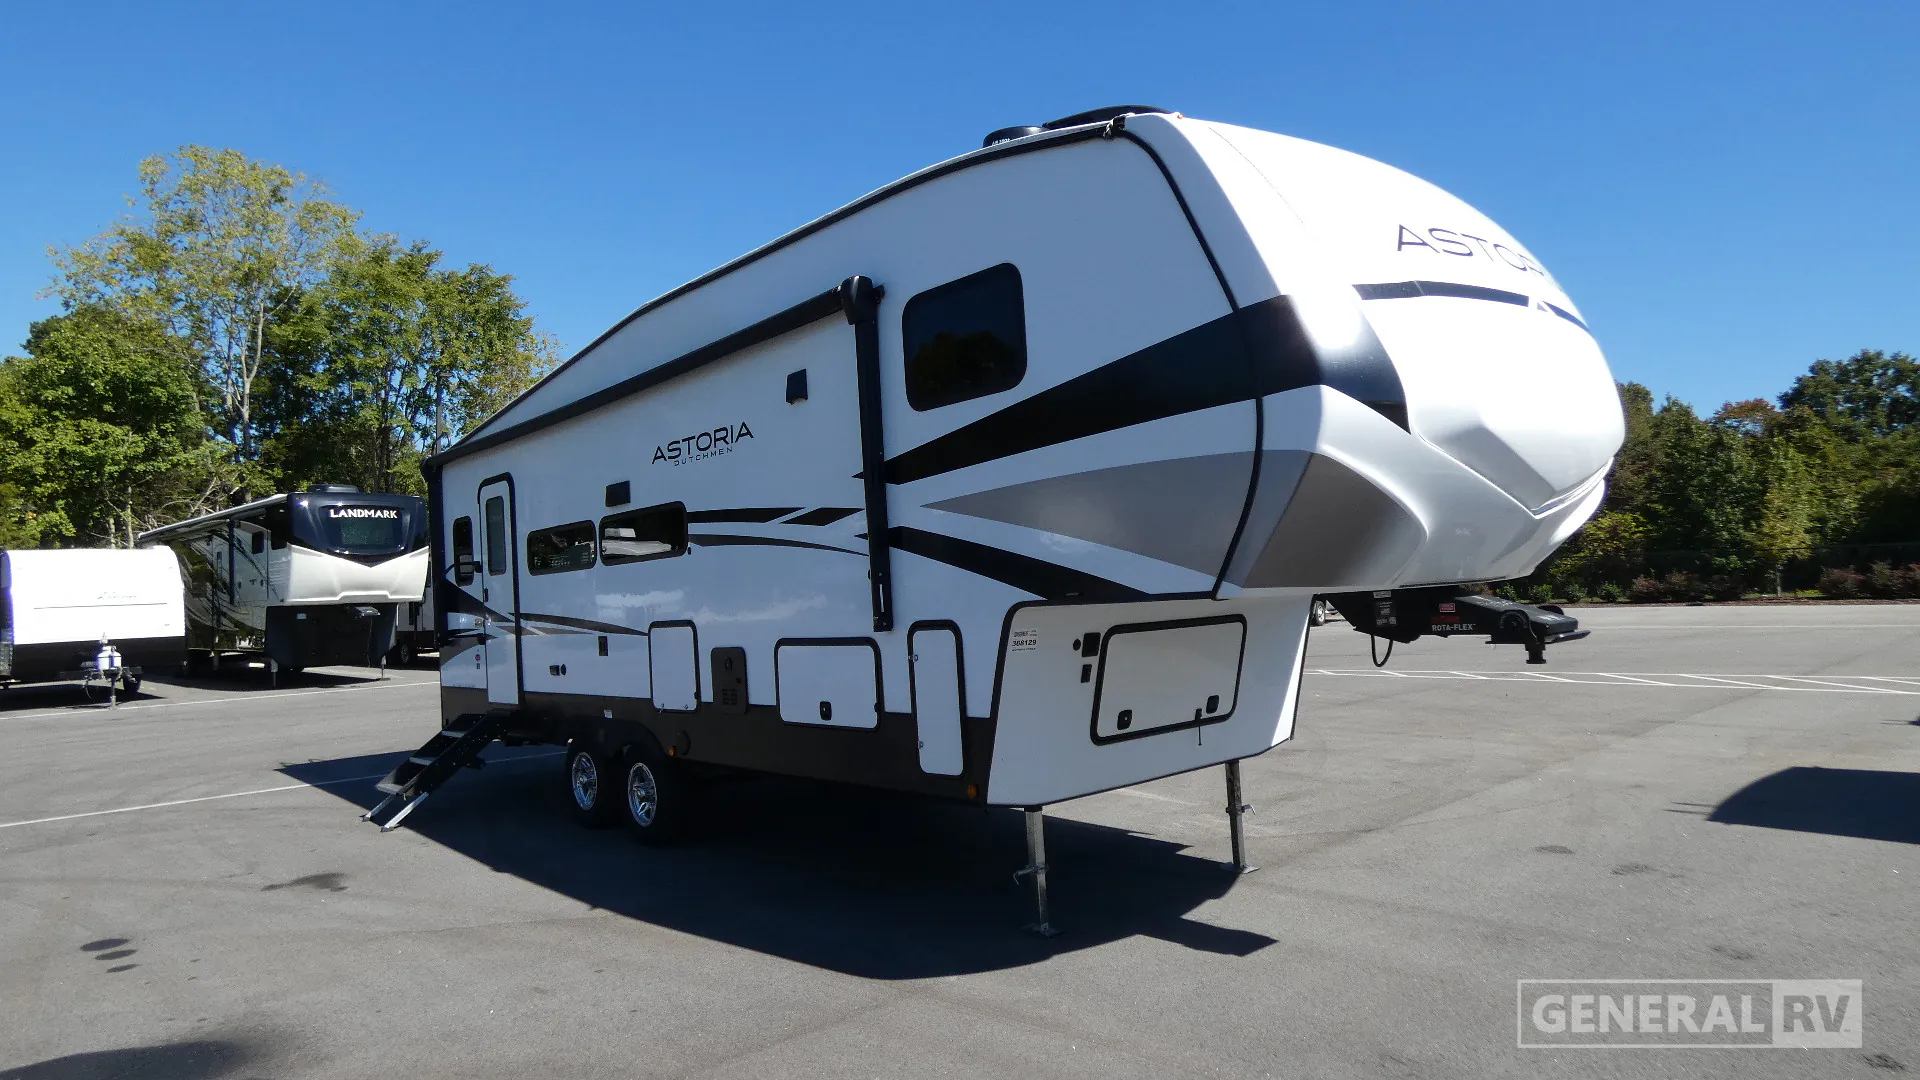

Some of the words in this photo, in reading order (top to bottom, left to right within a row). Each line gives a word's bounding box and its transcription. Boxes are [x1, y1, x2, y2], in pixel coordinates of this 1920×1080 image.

[1397, 224, 1546, 278] ASTOR
[651, 421, 754, 465] ASTORIA
[673, 446, 733, 467] DUTCHMEN
[329, 508, 398, 519] LANDMARK
